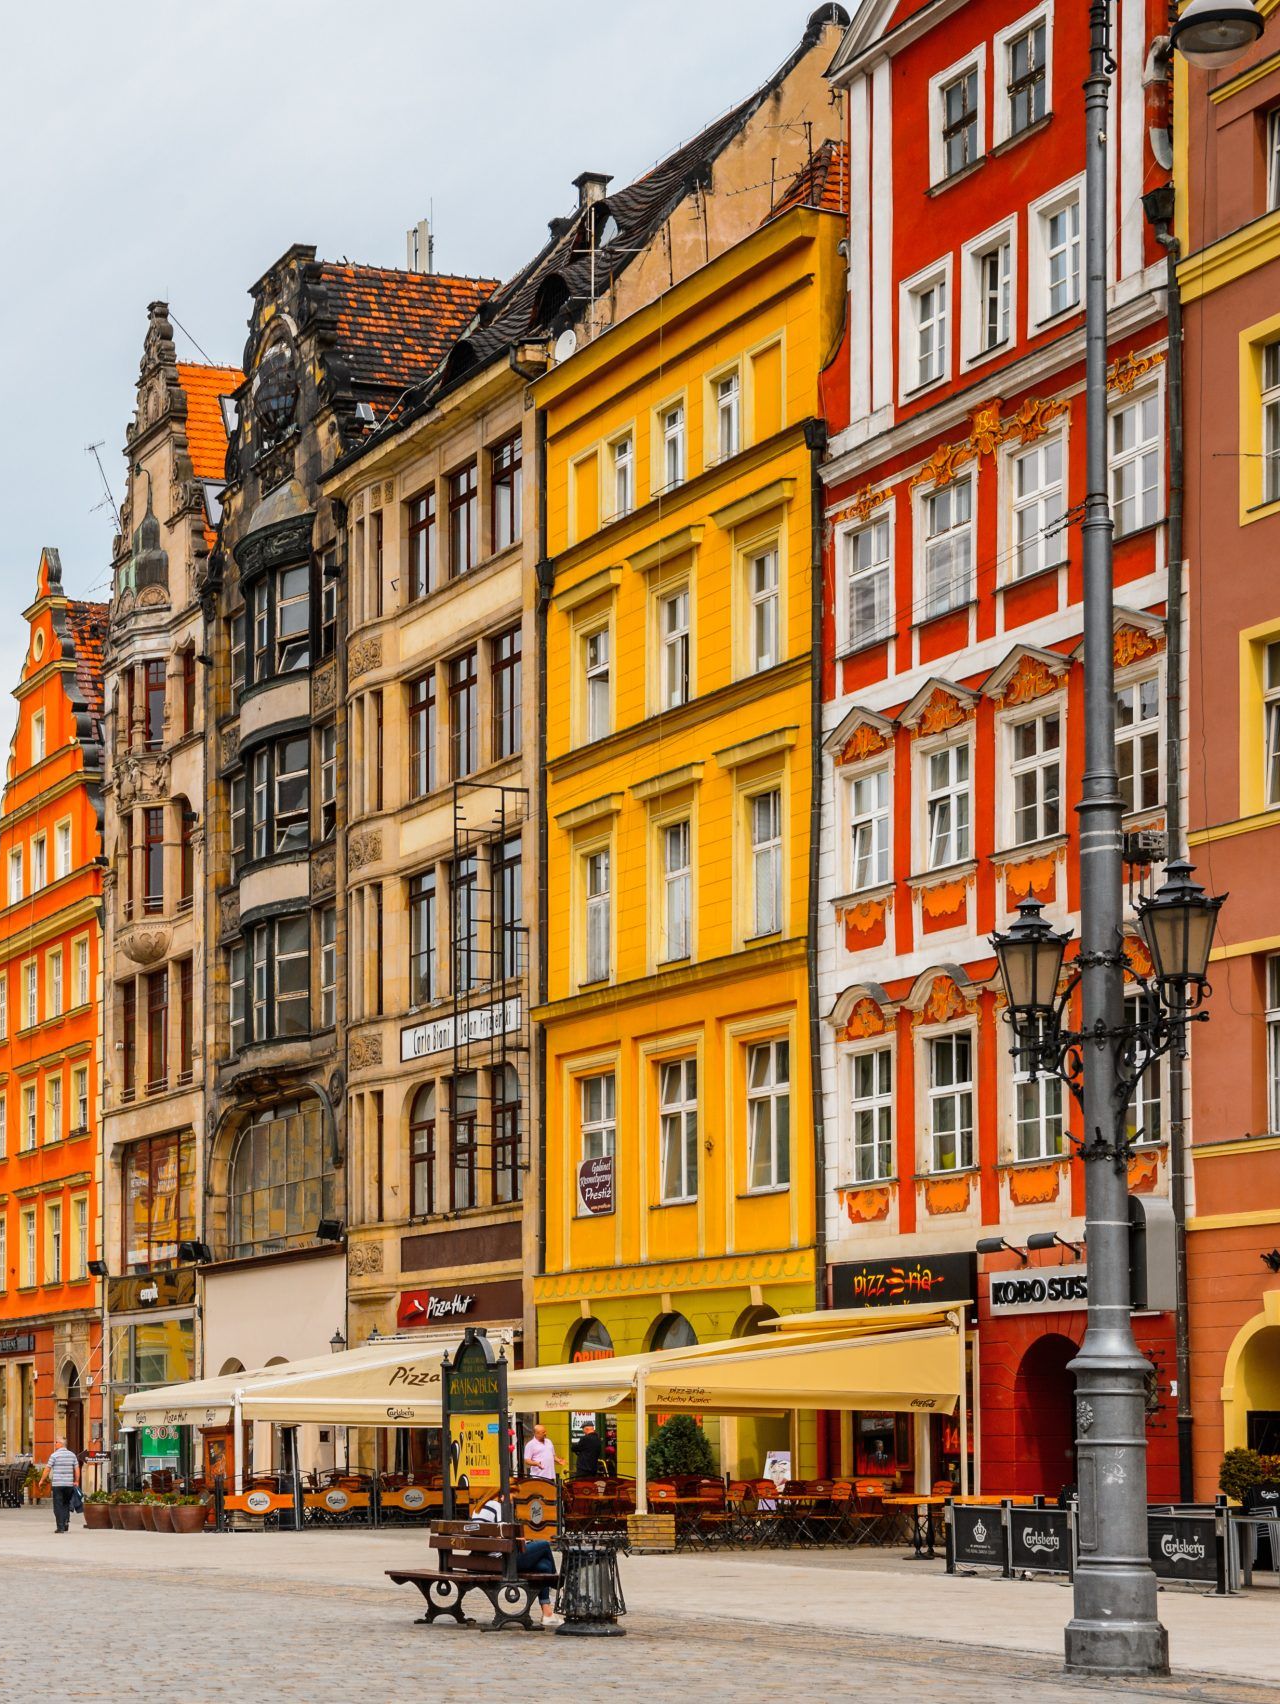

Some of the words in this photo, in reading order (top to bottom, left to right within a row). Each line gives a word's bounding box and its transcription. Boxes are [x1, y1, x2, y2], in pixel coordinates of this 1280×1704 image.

[413, 1025, 431, 1056] Carlo
[460, 1015, 477, 1040] Saon
[991, 1280, 1047, 1306] KOBO
[426, 1296, 452, 1319] Pizza
[451, 1294, 472, 1315] Hut
[388, 1366, 441, 1387] Pizza
[387, 1407, 415, 1420] Carlsberg
[1022, 1527, 1060, 1553] Carlsberg
[1160, 1534, 1206, 1563] Carlsberg
